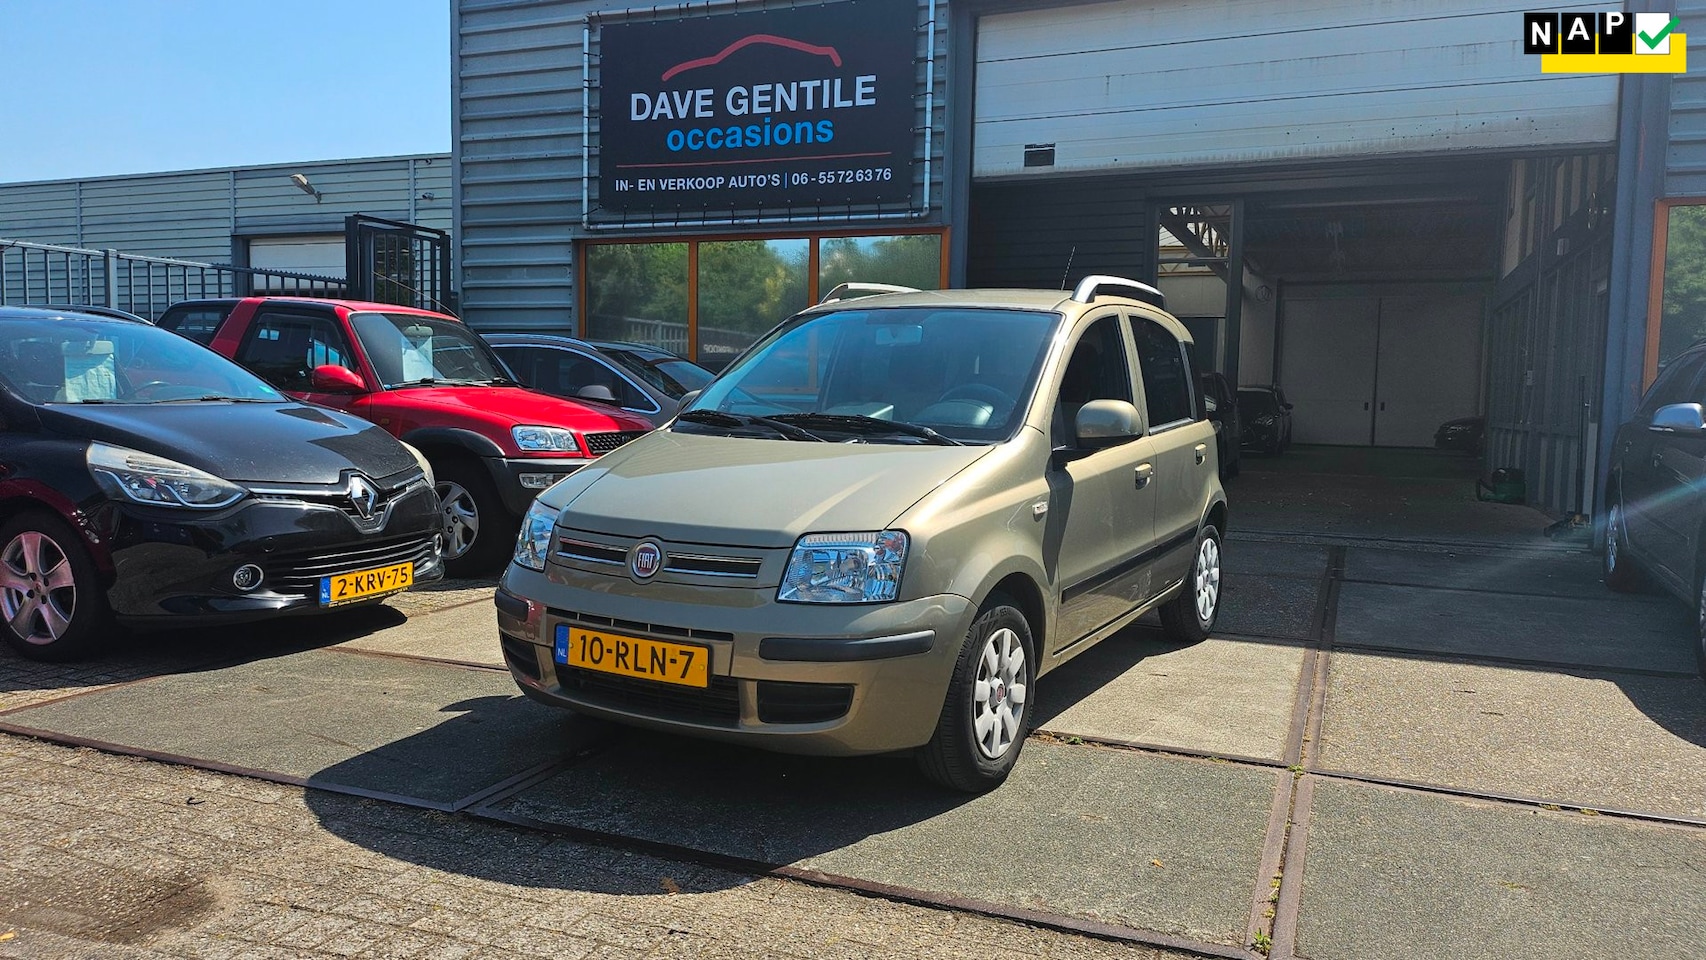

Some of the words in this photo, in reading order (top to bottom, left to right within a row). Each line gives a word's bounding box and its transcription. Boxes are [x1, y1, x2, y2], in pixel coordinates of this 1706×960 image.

[631, 89, 714, 121] DAVE
[725, 75, 877, 116] GENTILE
[667, 117, 834, 151] occasions
[615, 179, 634, 192] IN-
[637, 178, 656, 192] EN
[658, 176, 726, 191] VERKOOP
[728, 173, 781, 189] AUTO'S
[637, 552, 656, 569] FIAT
[337, 566, 408, 598] 2-KRV-75
[557, 647, 568, 659] NL
[580, 634, 695, 679] 10-RLN-7
